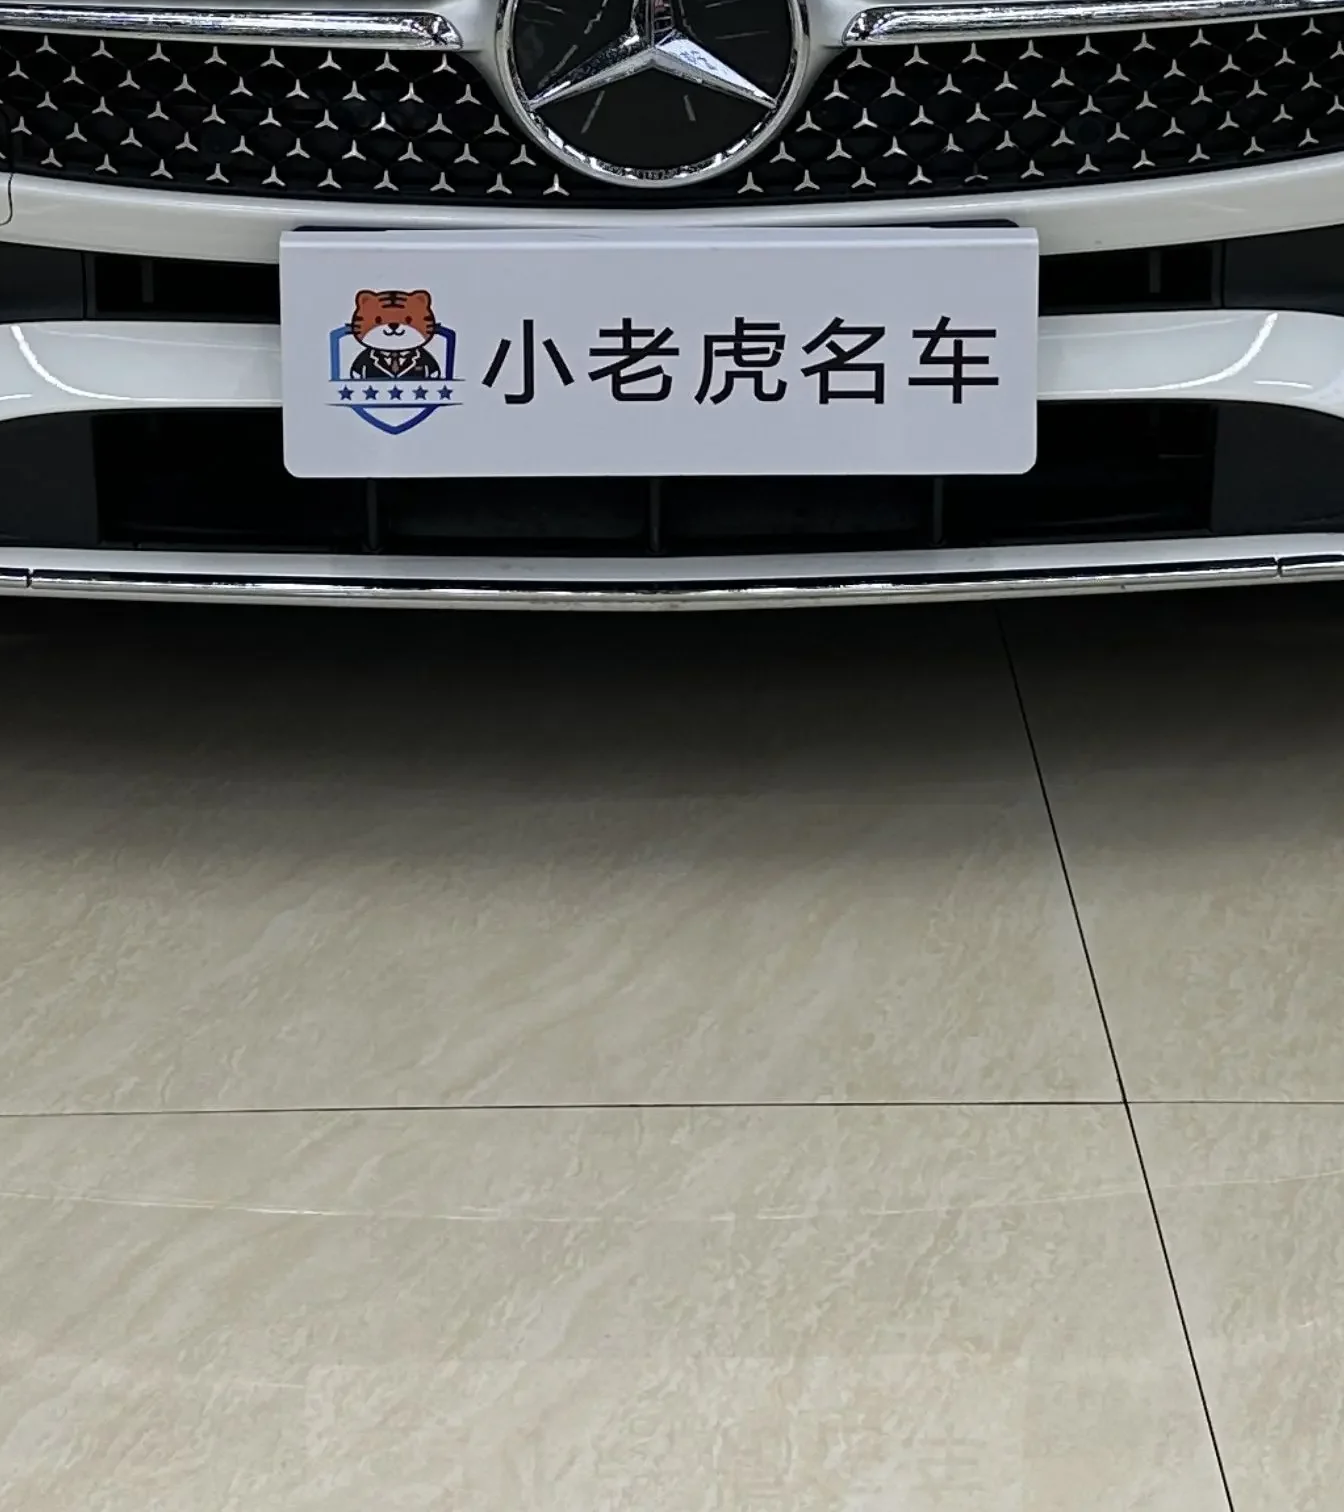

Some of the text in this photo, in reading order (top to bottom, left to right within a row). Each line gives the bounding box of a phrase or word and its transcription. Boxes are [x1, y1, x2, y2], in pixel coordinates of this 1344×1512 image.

[481, 314, 1001, 406] 小老虎名车
